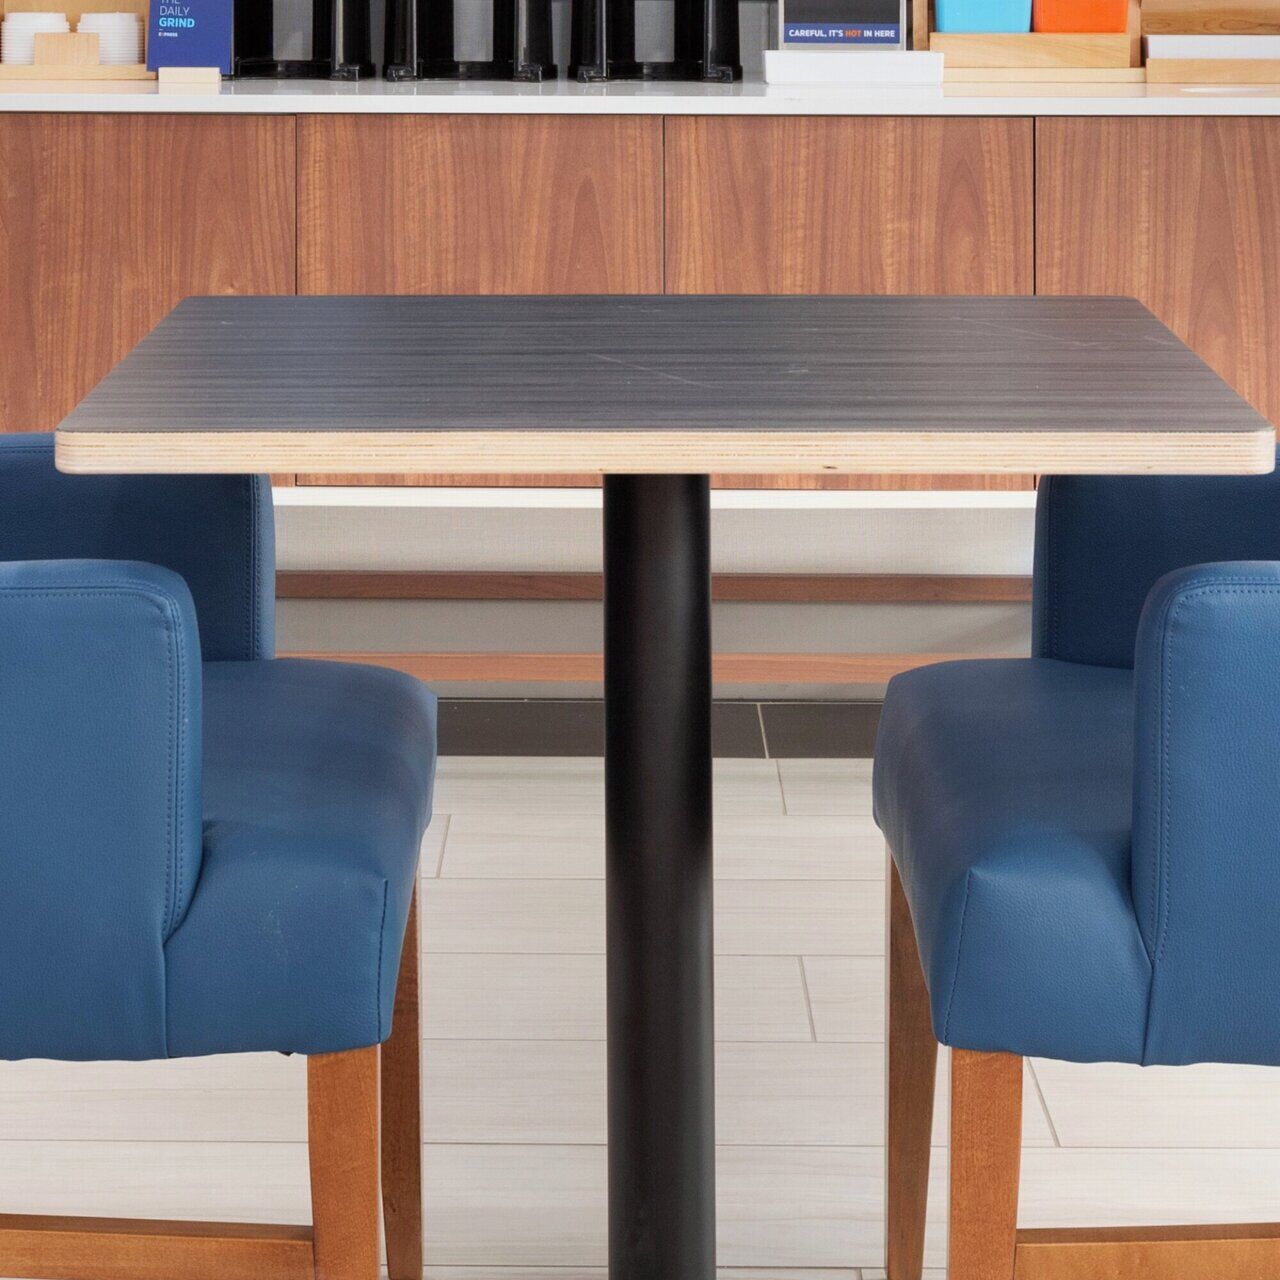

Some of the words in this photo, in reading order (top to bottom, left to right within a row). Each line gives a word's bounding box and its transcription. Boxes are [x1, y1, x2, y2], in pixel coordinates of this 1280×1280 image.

[159, 5, 191, 17] DAILY
[158, 17, 196, 29] GRIND
[829, 29, 843, 38] IT'S
[845, 29, 862, 38] HOT
[863, 29, 873, 38] IN
[874, 29, 895, 38] HERE
